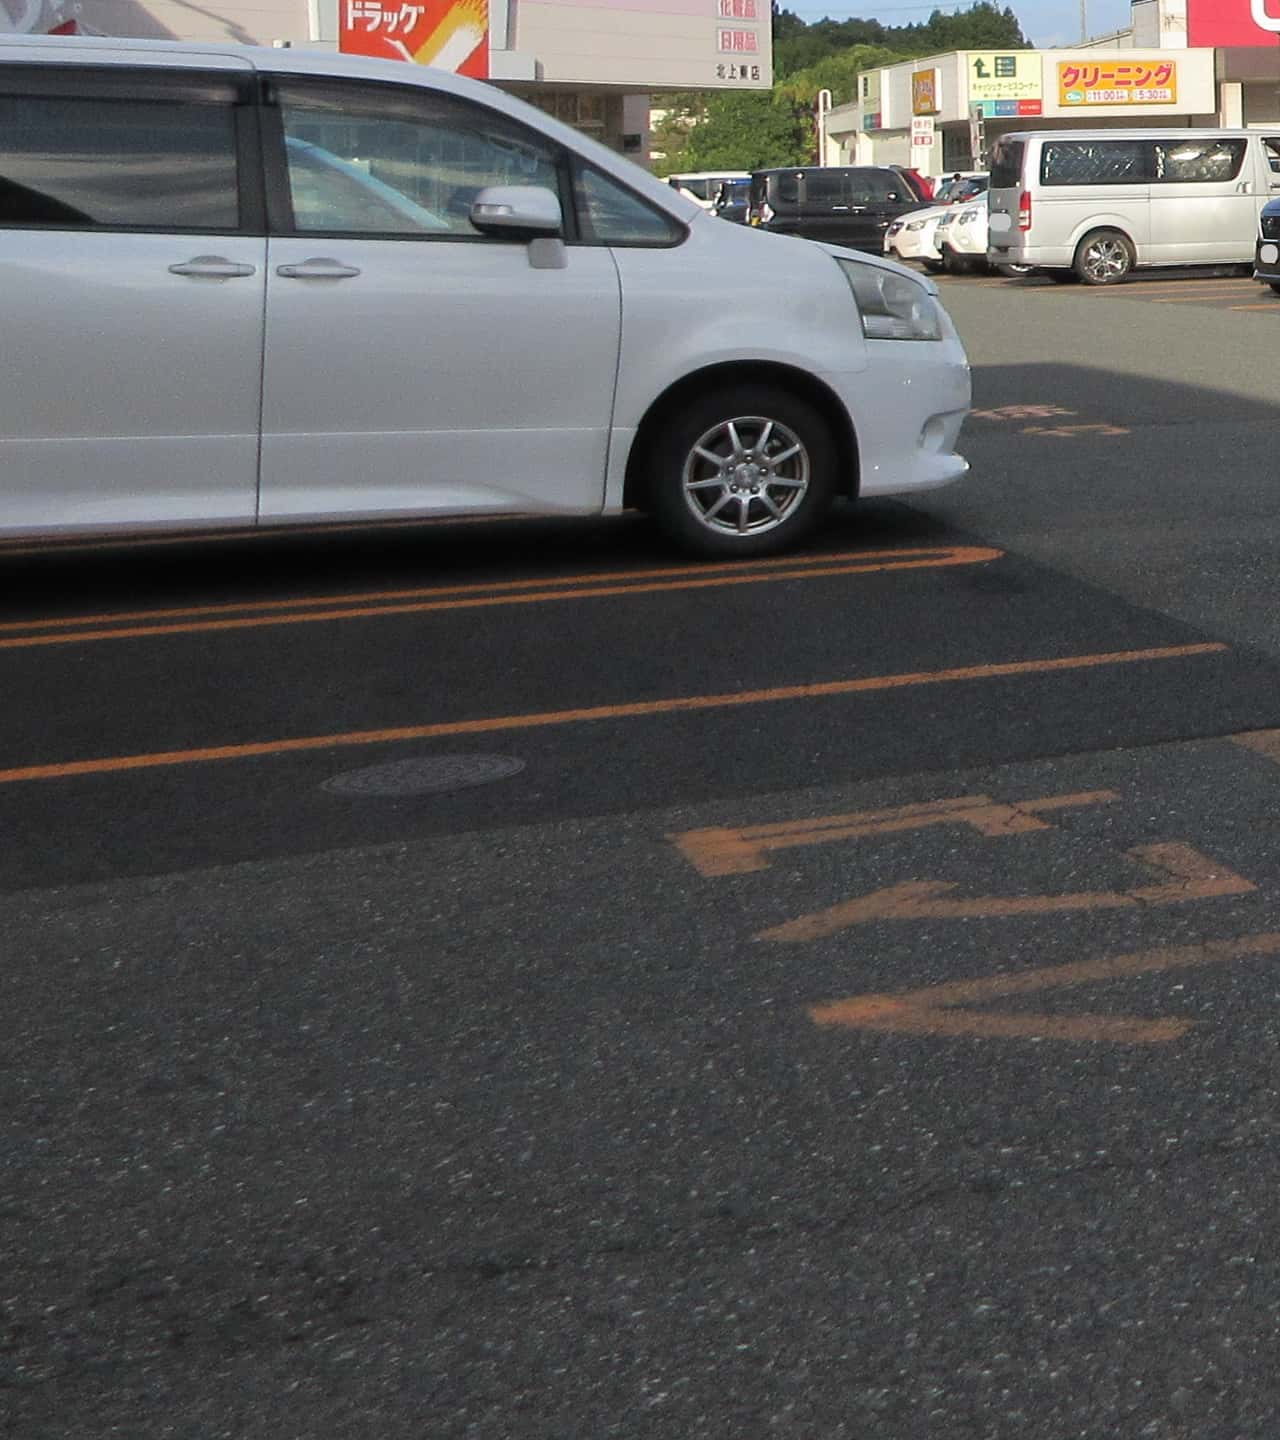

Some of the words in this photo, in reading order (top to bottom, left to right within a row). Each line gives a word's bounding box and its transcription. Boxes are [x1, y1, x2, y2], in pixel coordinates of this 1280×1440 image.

[346, 0, 425, 34] ドラッグ
[1062, 63, 1173, 87] クリーニング
